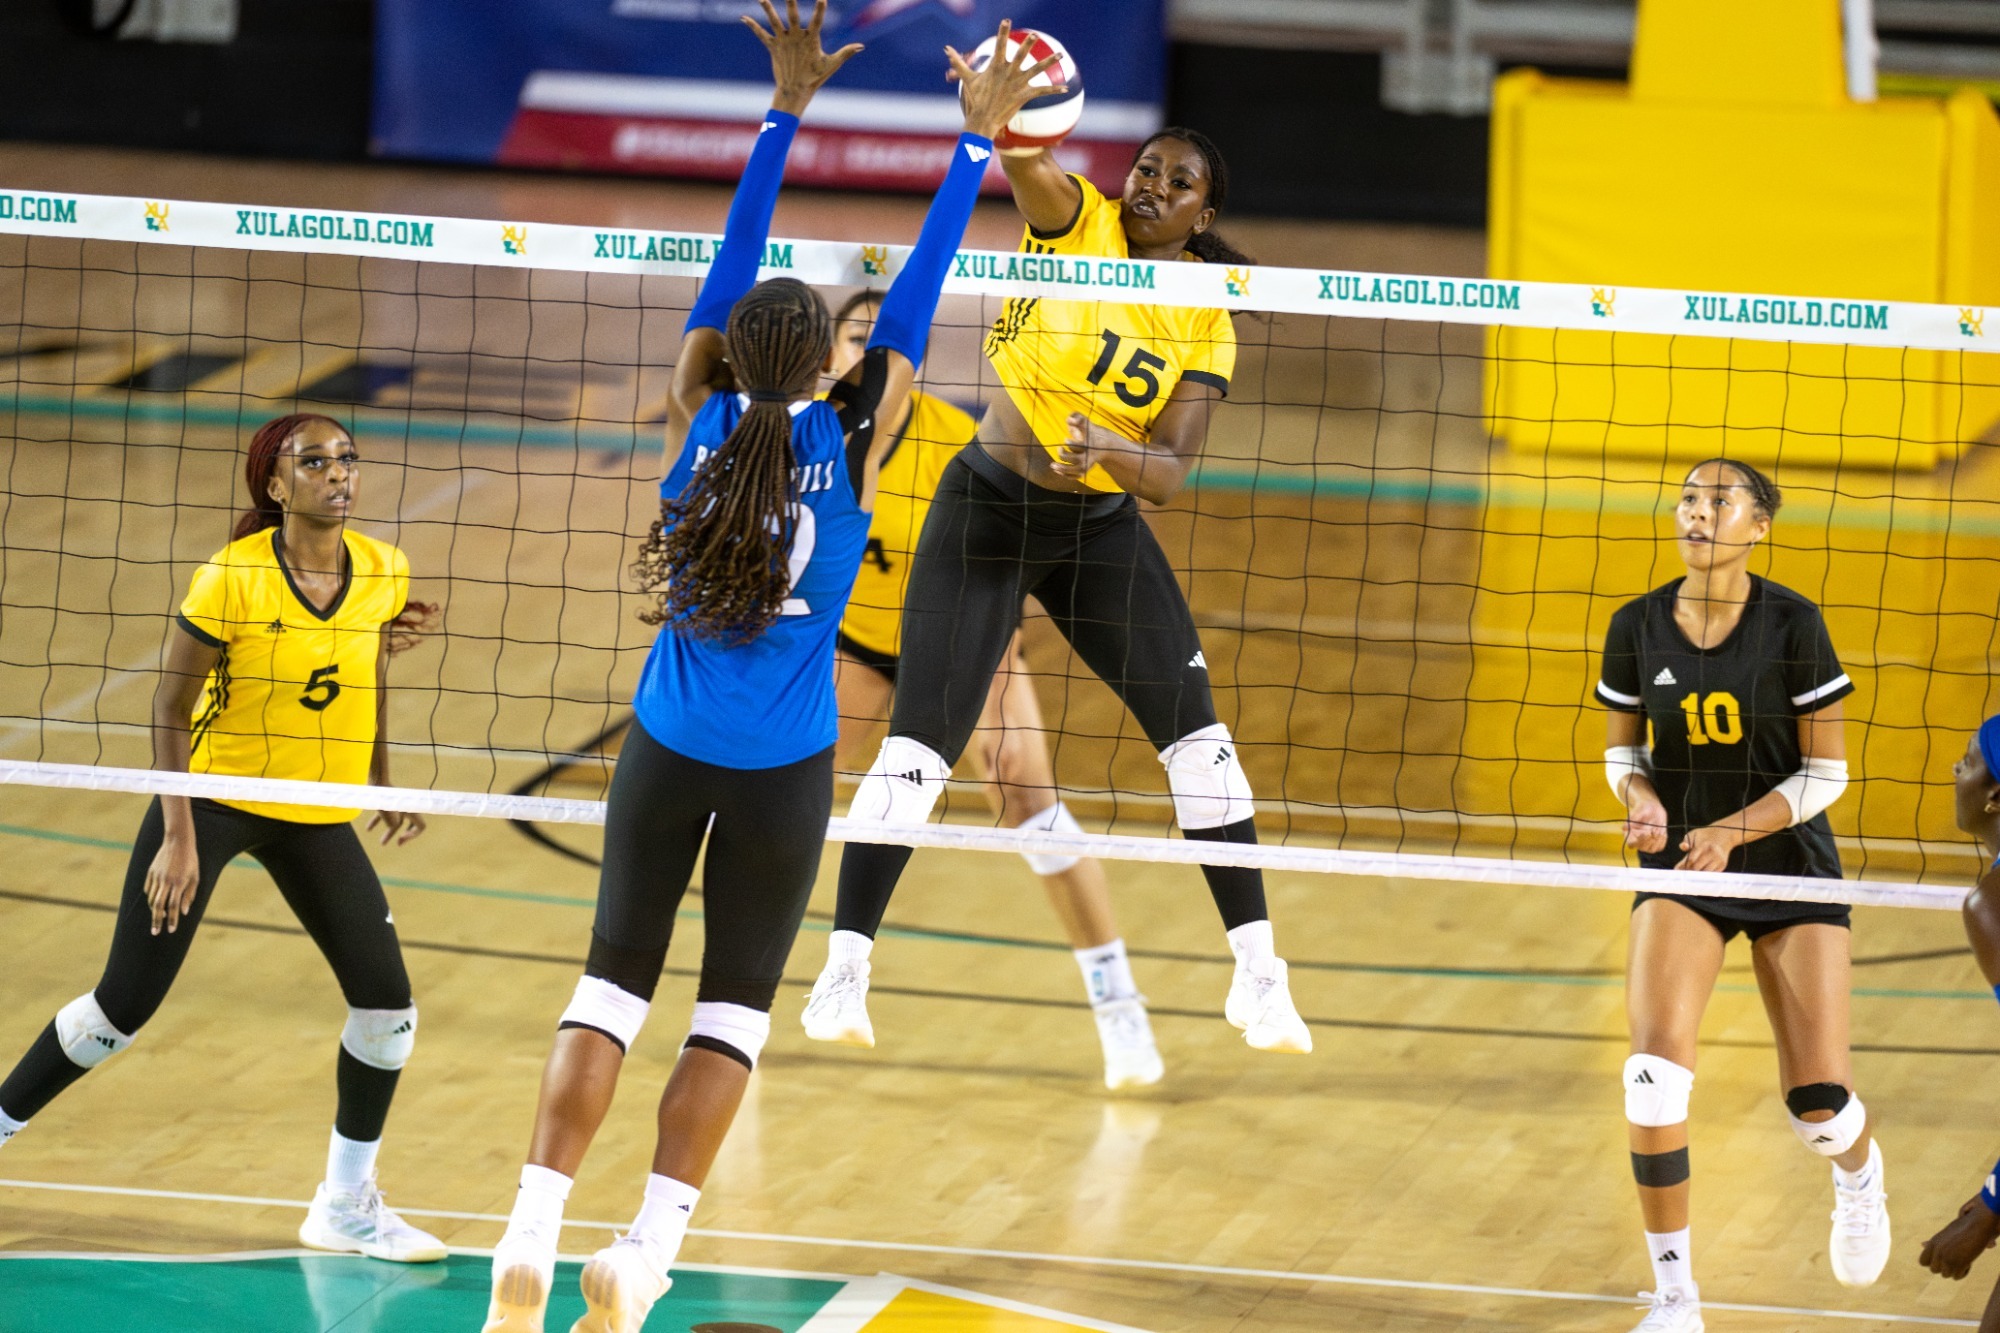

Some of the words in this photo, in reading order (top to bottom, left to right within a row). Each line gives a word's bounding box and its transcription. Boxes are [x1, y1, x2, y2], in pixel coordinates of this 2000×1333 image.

[236, 210, 434, 247] XULAGOLD.COM
[954, 253, 1155, 290] XULAGOLD.COM
[1318, 274, 1520, 310] XULAGOLD.COM
[1684, 295, 1889, 330] XULAGOLD.COM
[1086, 328, 1166, 408] 15
[299, 664, 340, 711] 5
[1680, 691, 1743, 745] 10
